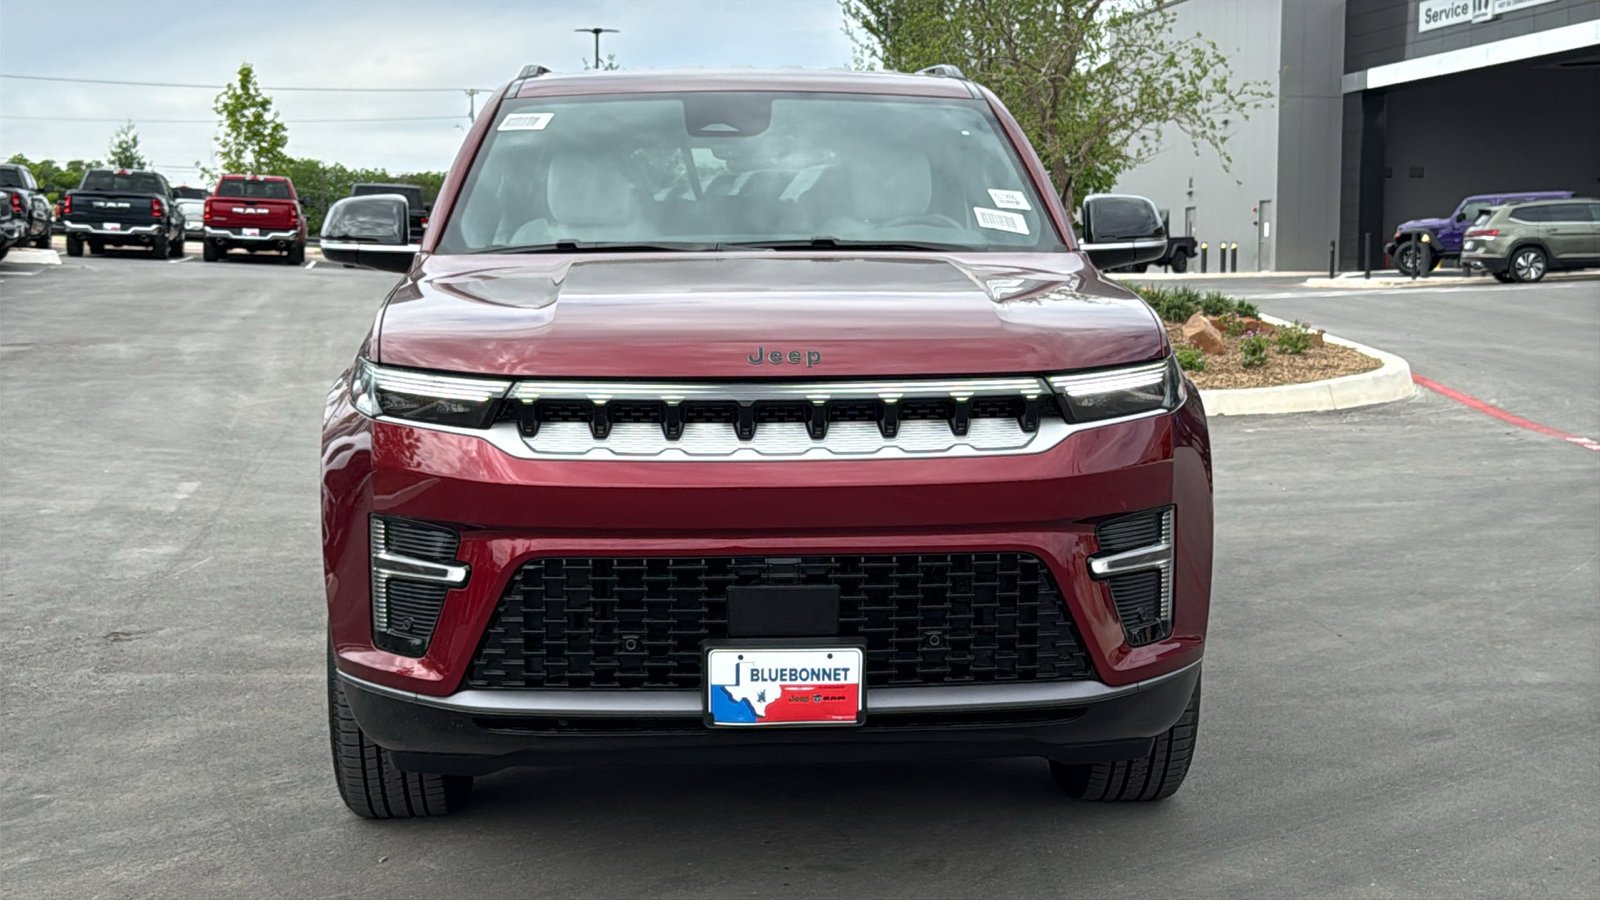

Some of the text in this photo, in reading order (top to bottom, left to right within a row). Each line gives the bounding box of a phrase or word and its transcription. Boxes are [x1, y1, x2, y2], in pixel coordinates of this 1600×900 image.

[1424, 2, 1469, 24] Service
[747, 346, 822, 368] Jeep
[750, 667, 850, 682] BLUEBONNET
